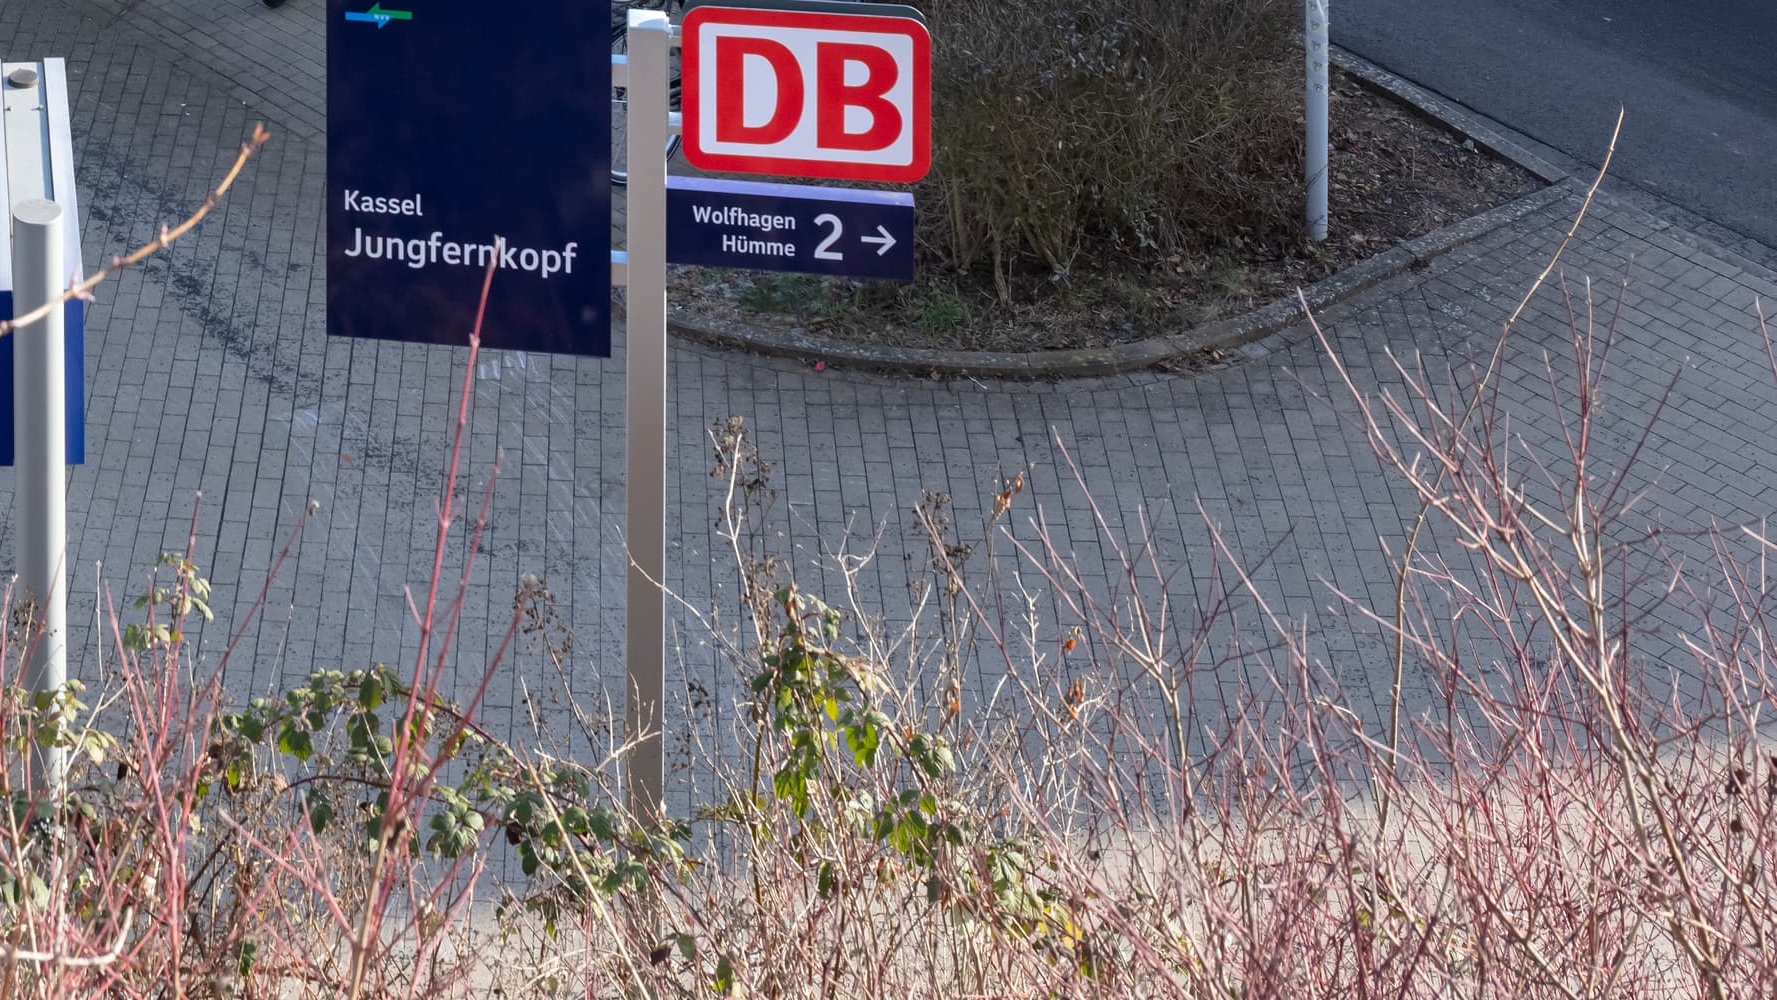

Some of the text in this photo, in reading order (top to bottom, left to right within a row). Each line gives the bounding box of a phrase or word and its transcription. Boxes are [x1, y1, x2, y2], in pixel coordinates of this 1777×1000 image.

[716, 36, 903, 151] DB
[343, 189, 423, 217] Kassel
[692, 205, 796, 232] Wolfhagen
[344, 228, 578, 279] Jungfernkopf
[722, 233, 796, 257] Hümme
[813, 213, 844, 261] 2
